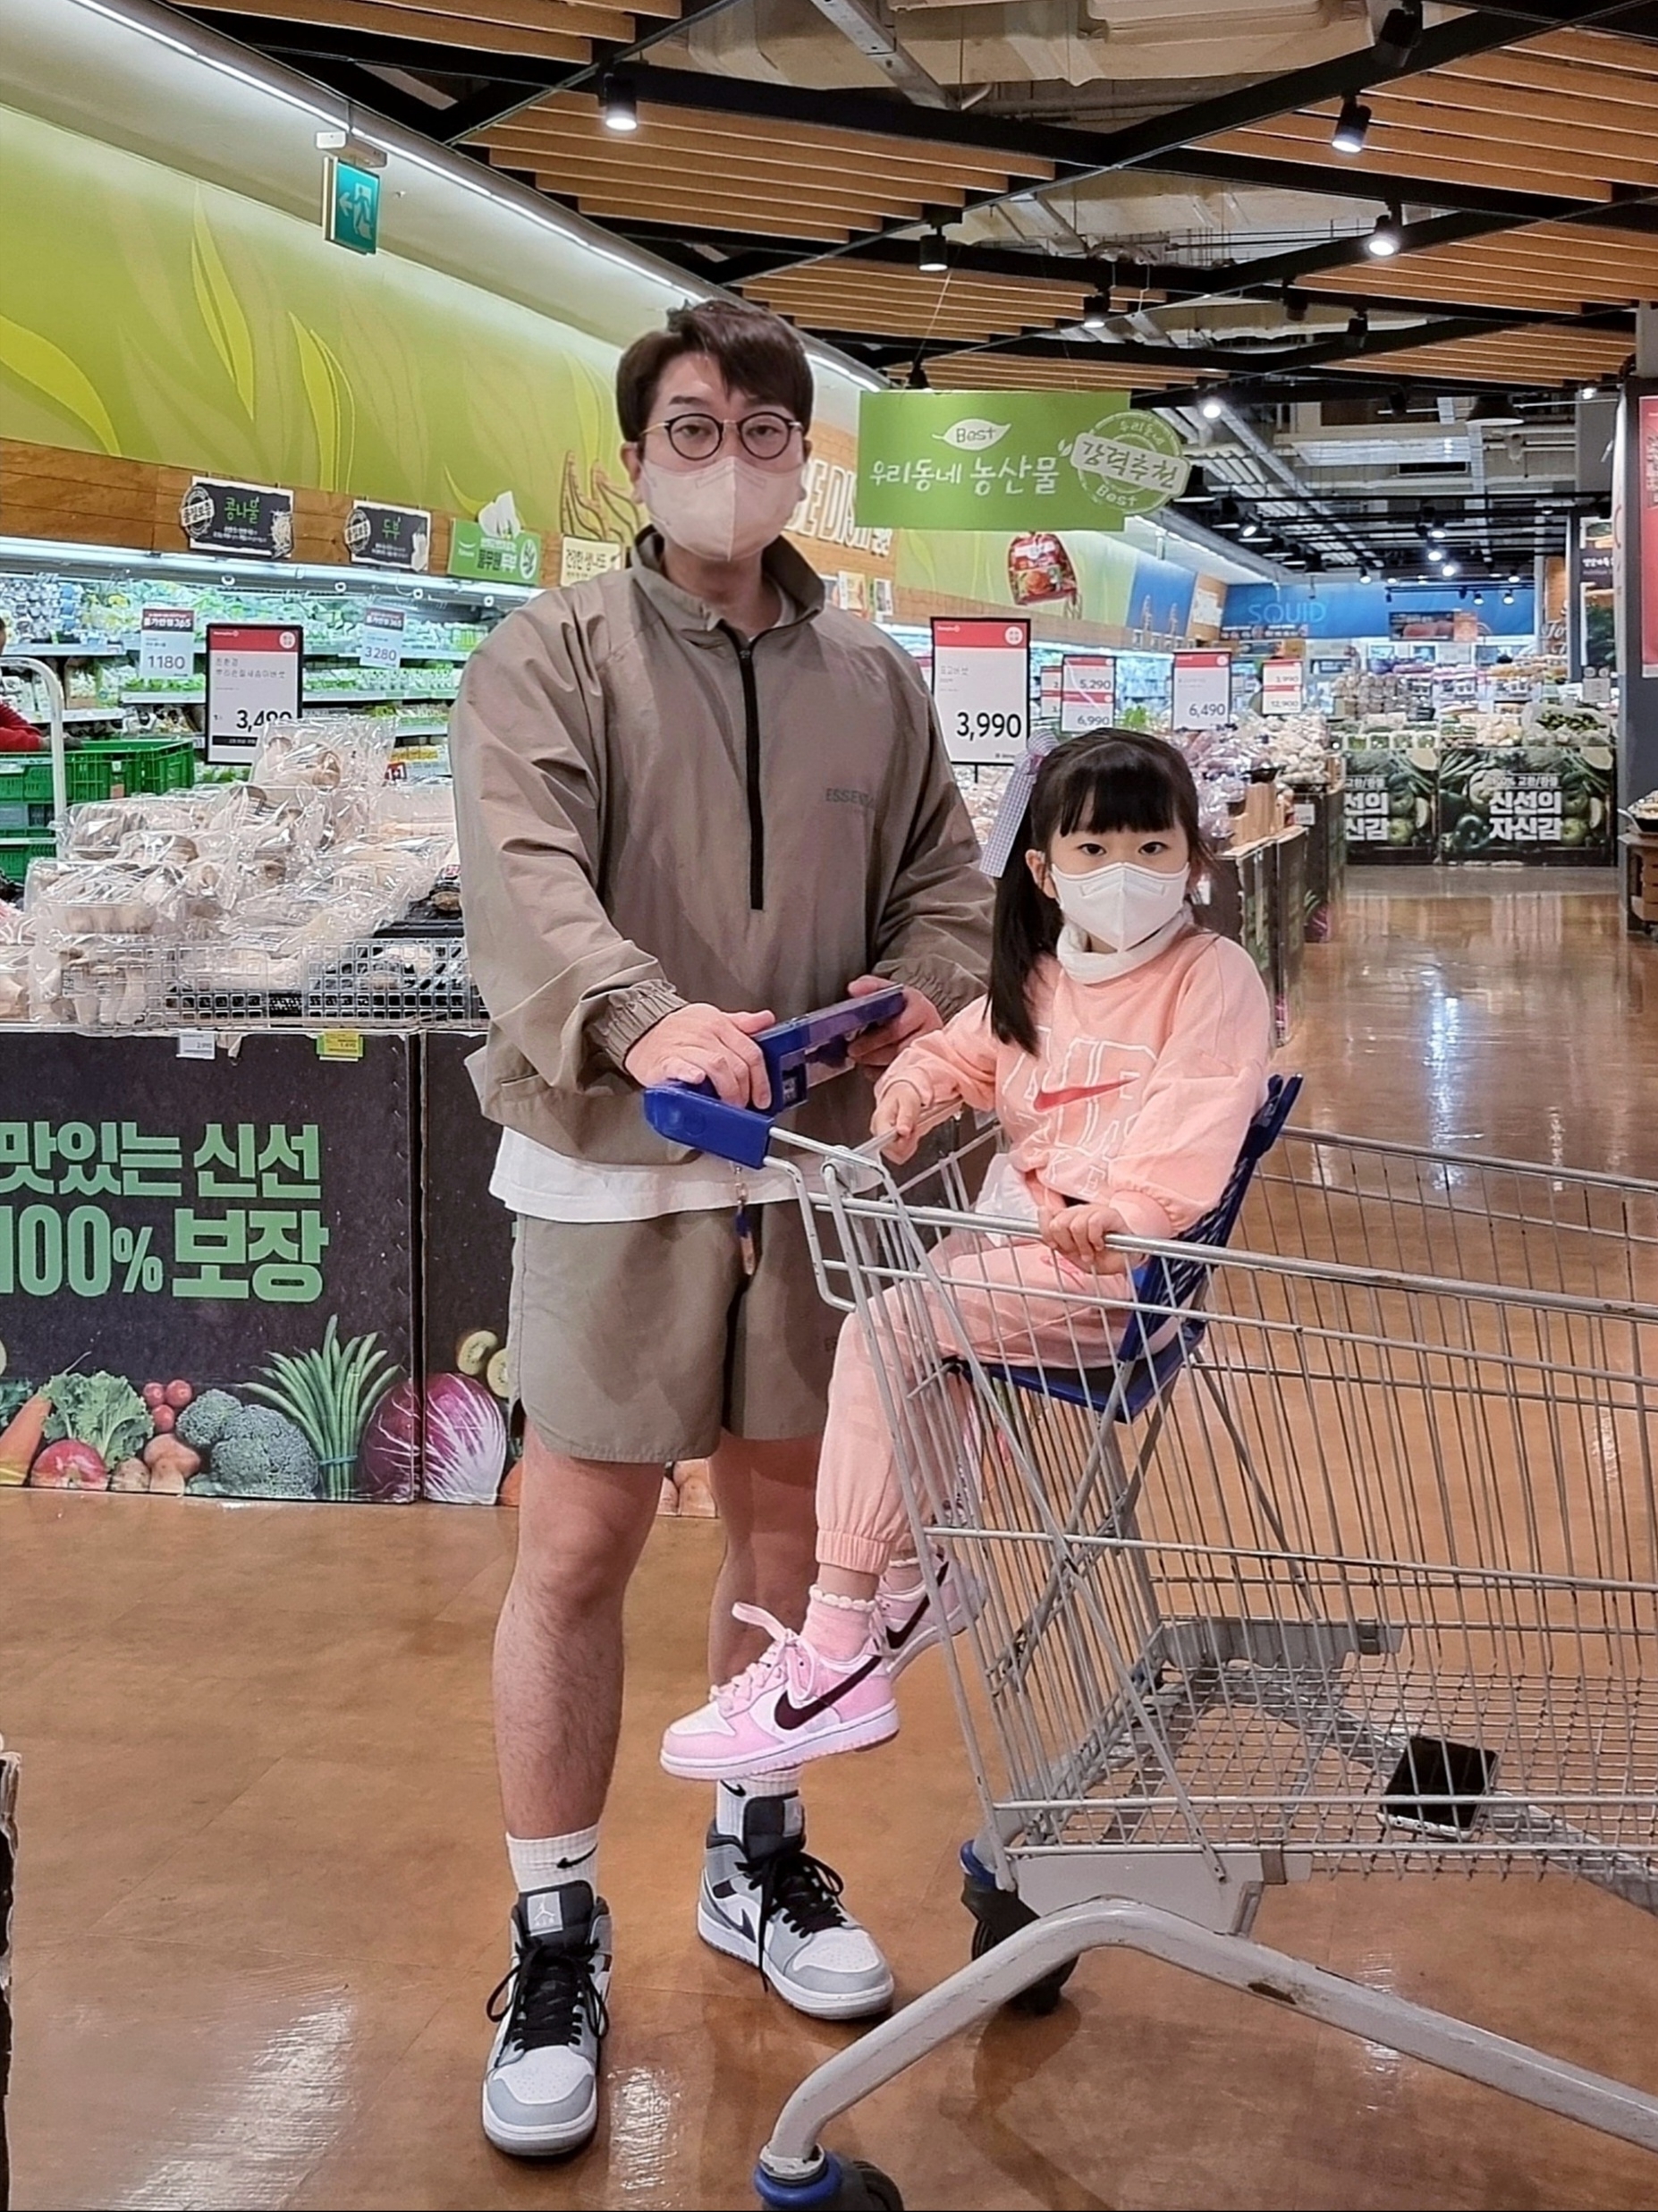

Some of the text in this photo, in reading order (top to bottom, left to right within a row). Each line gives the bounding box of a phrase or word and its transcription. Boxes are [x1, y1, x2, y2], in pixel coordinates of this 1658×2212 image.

[956, 427, 997, 443] Best
[869, 454, 1060, 496] 우리동네 농산물
[1082, 440, 1178, 489] 강력추천
[1095, 483, 1138, 506] Best
[224, 496, 260, 524] 콩나물
[382, 518, 401, 541] 두부
[1248, 600, 1329, 625] SQUID
[148, 656, 185, 670] 1180
[365, 646, 397, 661] 3280
[1079, 679, 1112, 691] 5,290
[1189, 702, 1226, 718] 6,490
[956, 711, 1022, 742] 3,990
[1343, 792, 1389, 816] 선의
[1489, 791, 1562, 815] 신선의
[1344, 818, 1390, 841] 신감
[1489, 817, 1563, 842] 자신감
[0, 1121, 322, 1199] 맛있는 신선
[0, 1204, 330, 1302] 100% 보장
